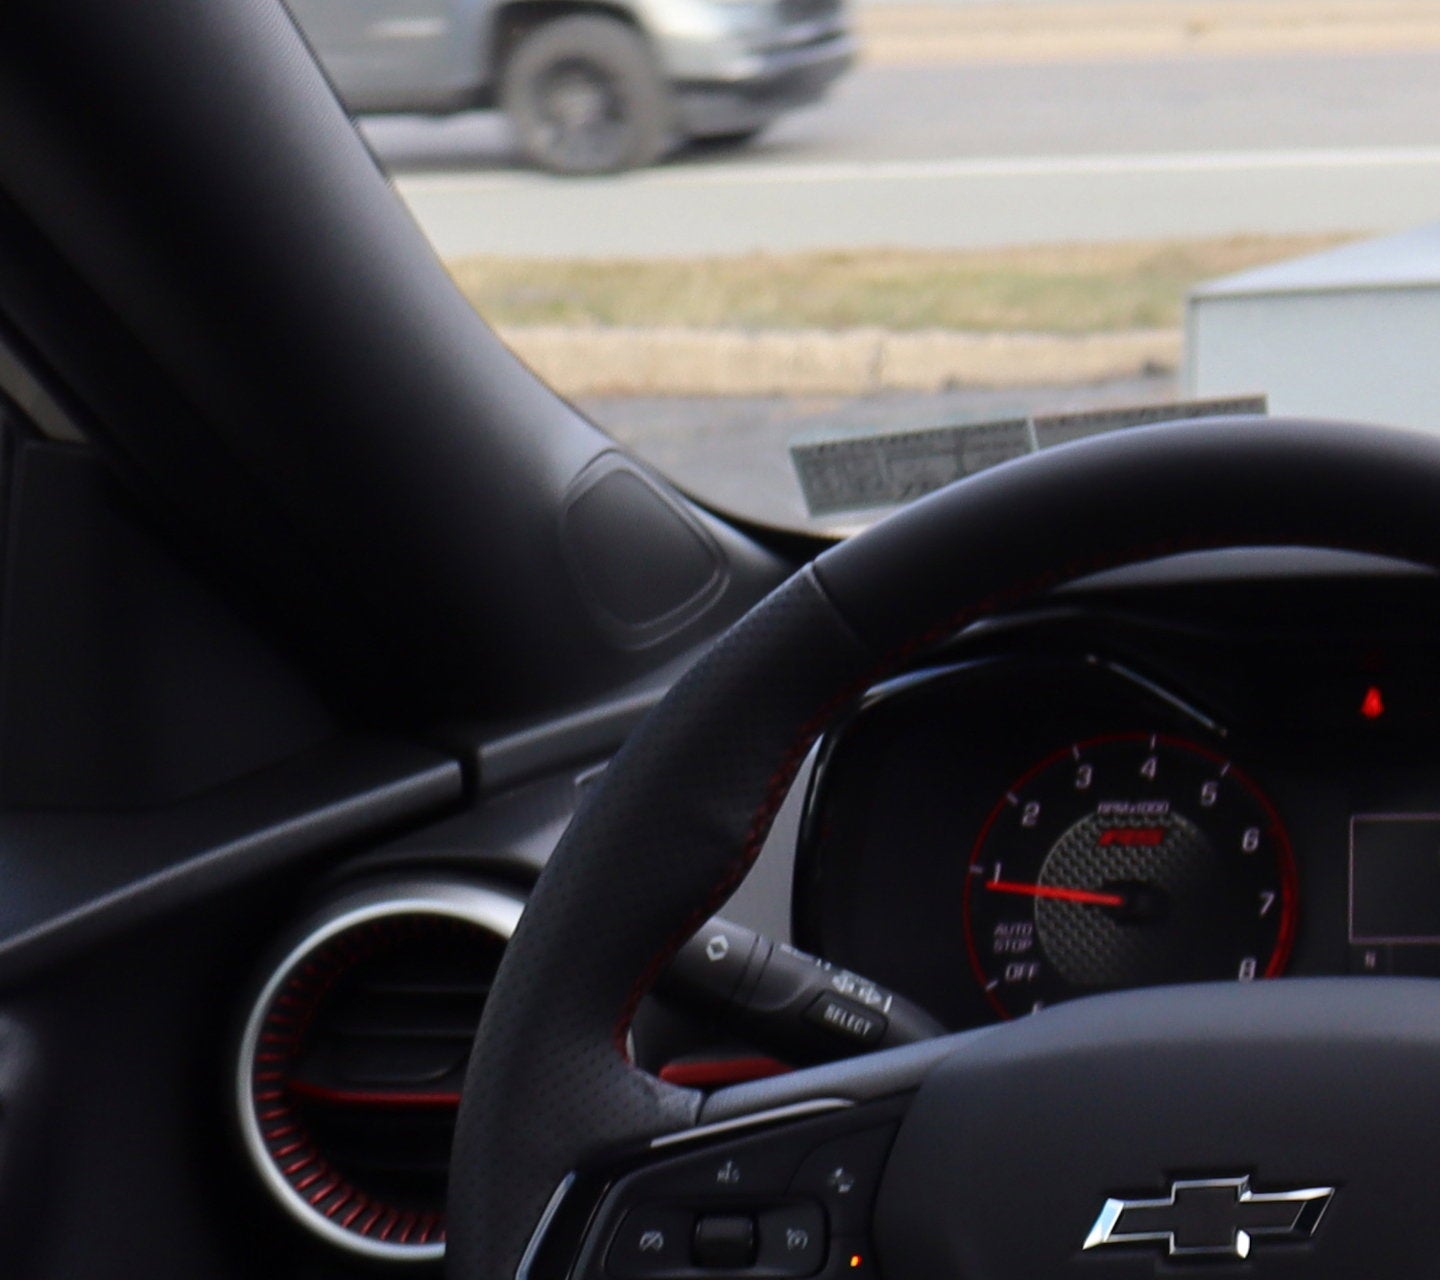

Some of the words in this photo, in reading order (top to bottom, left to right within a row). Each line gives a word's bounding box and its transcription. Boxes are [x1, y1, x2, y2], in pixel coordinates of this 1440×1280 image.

[1074, 763, 1094, 791] 3
[1141, 755, 1160, 780] 4
[1021, 801, 1041, 827] 2
[1241, 826, 1260, 852] 6
[1259, 891, 1276, 918] 7
[823, 1002, 872, 1038] SELECT
